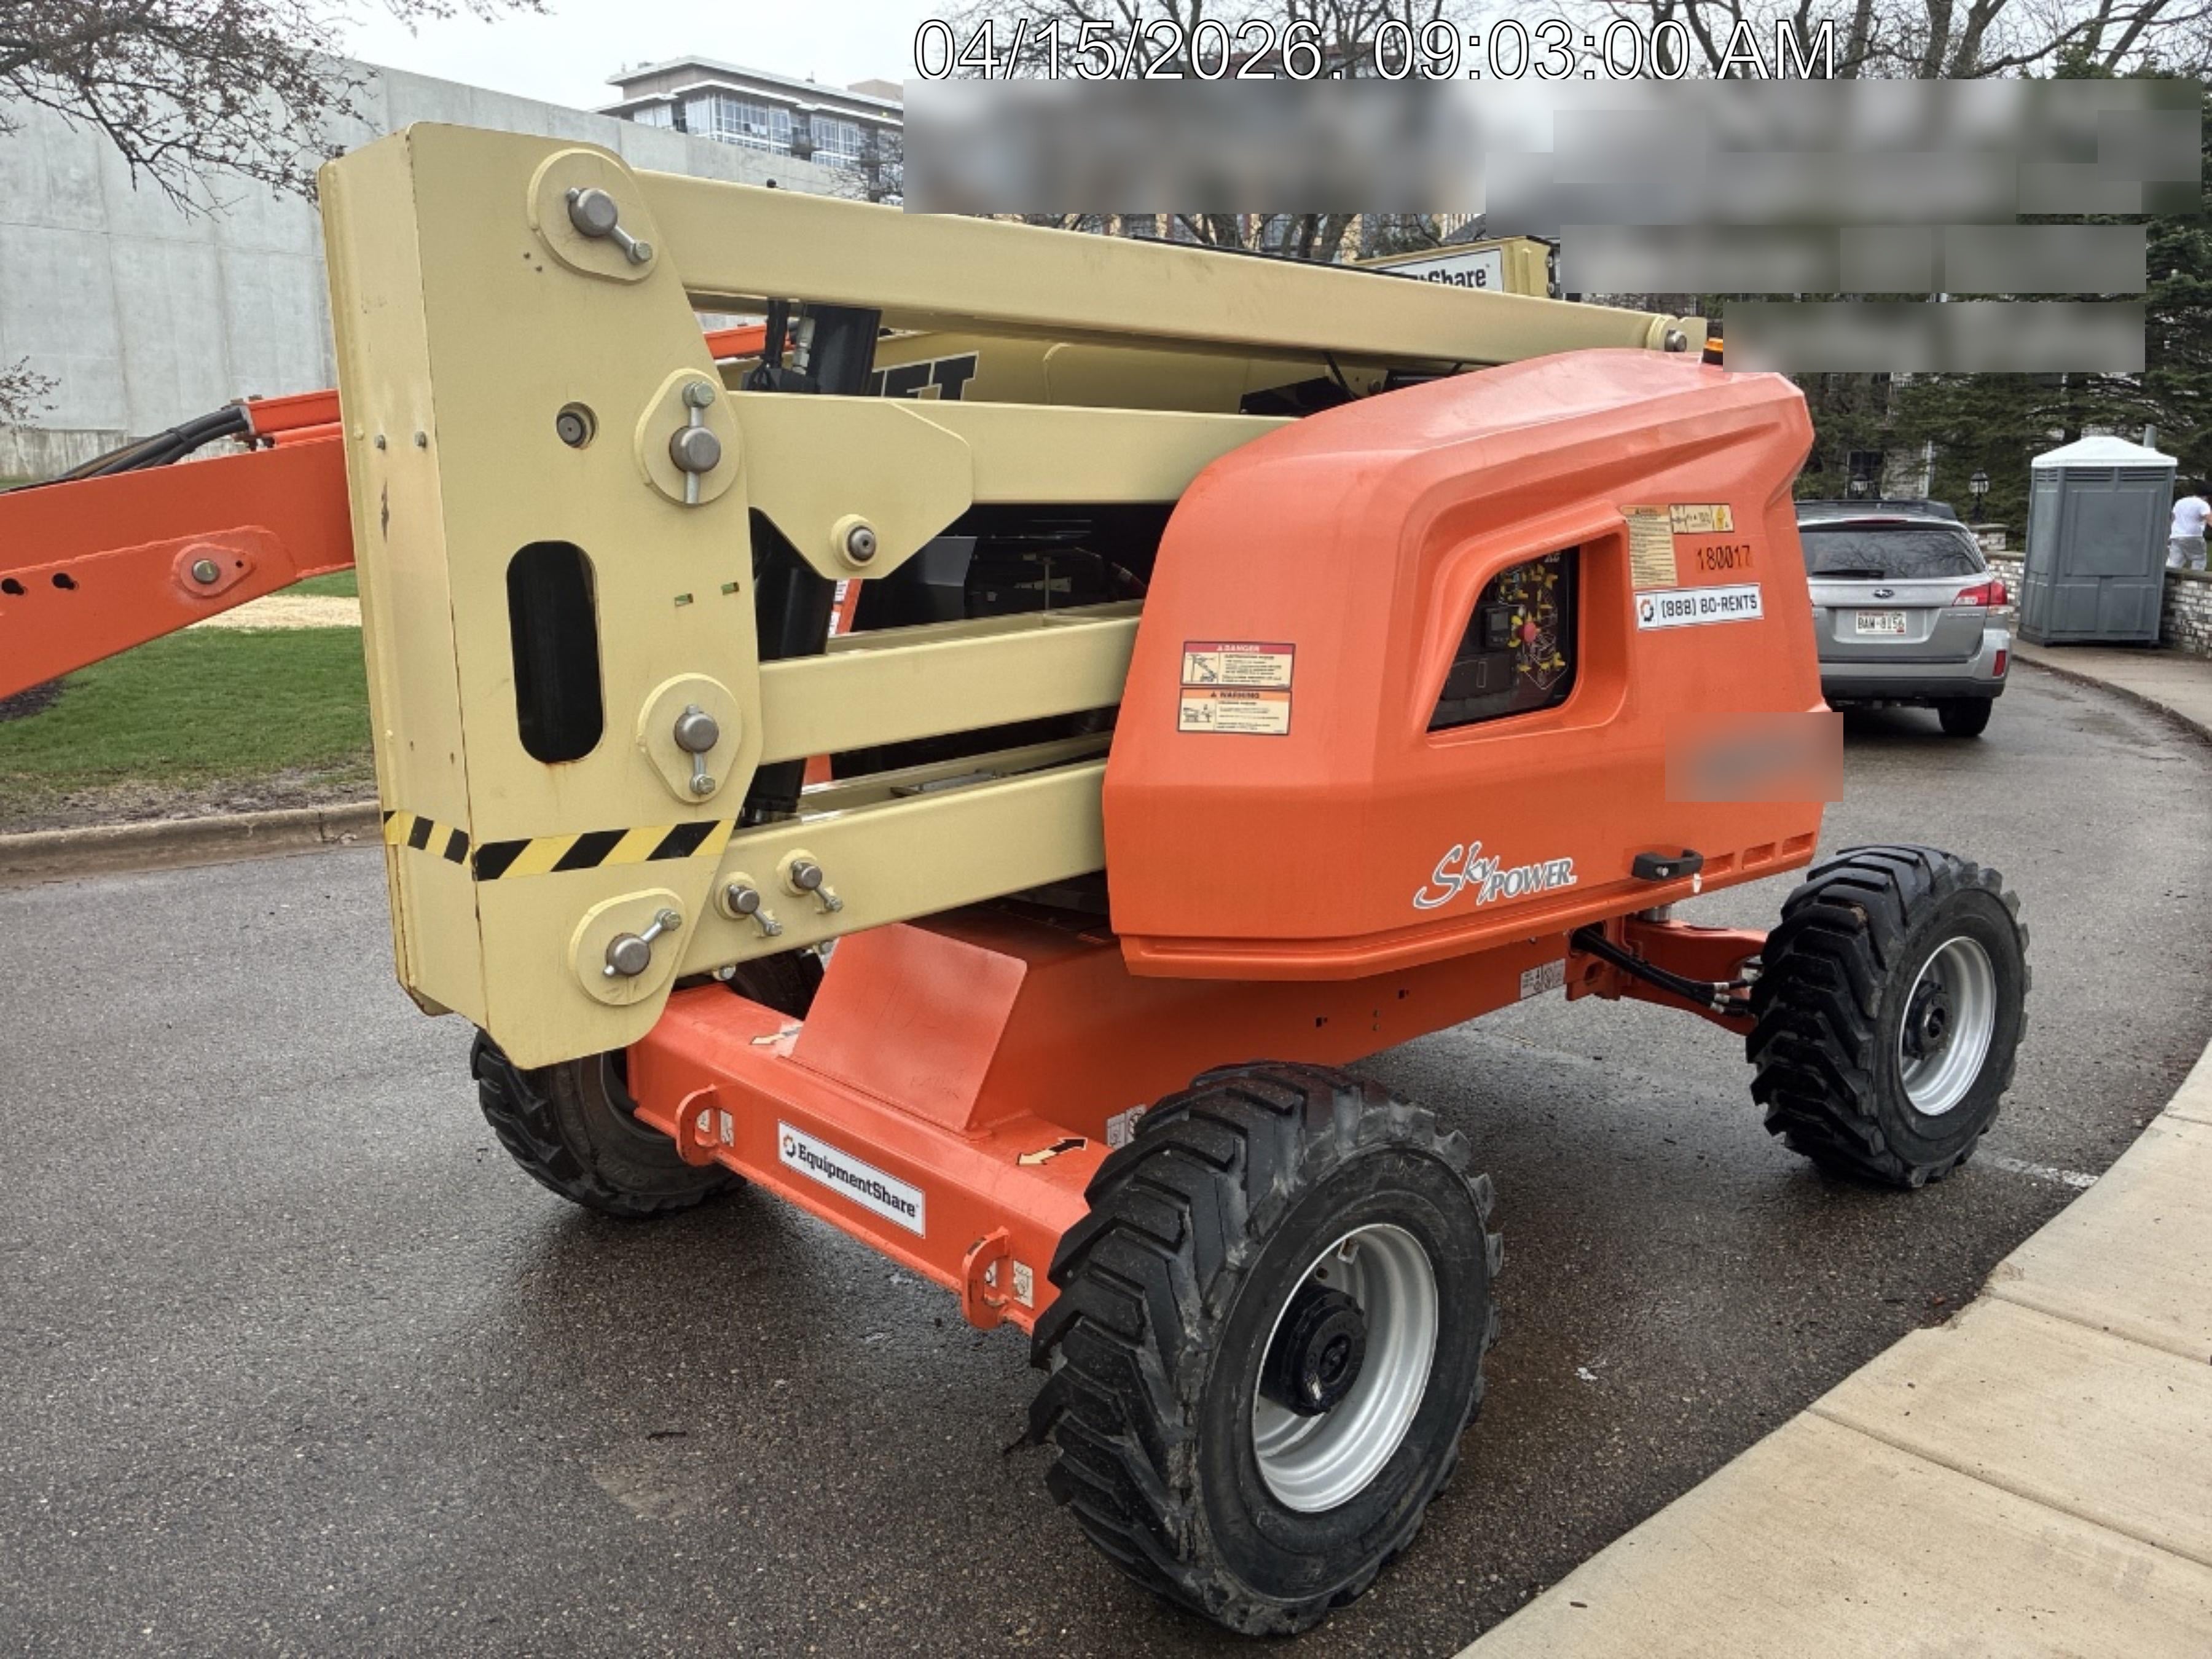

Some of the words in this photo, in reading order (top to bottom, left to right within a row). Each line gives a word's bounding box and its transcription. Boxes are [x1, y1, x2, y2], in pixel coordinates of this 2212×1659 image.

[1697, 544, 1751, 571] 180017
[1661, 598, 1696, 618] (888)
[798, 1142, 916, 1218] EquipmentShare
